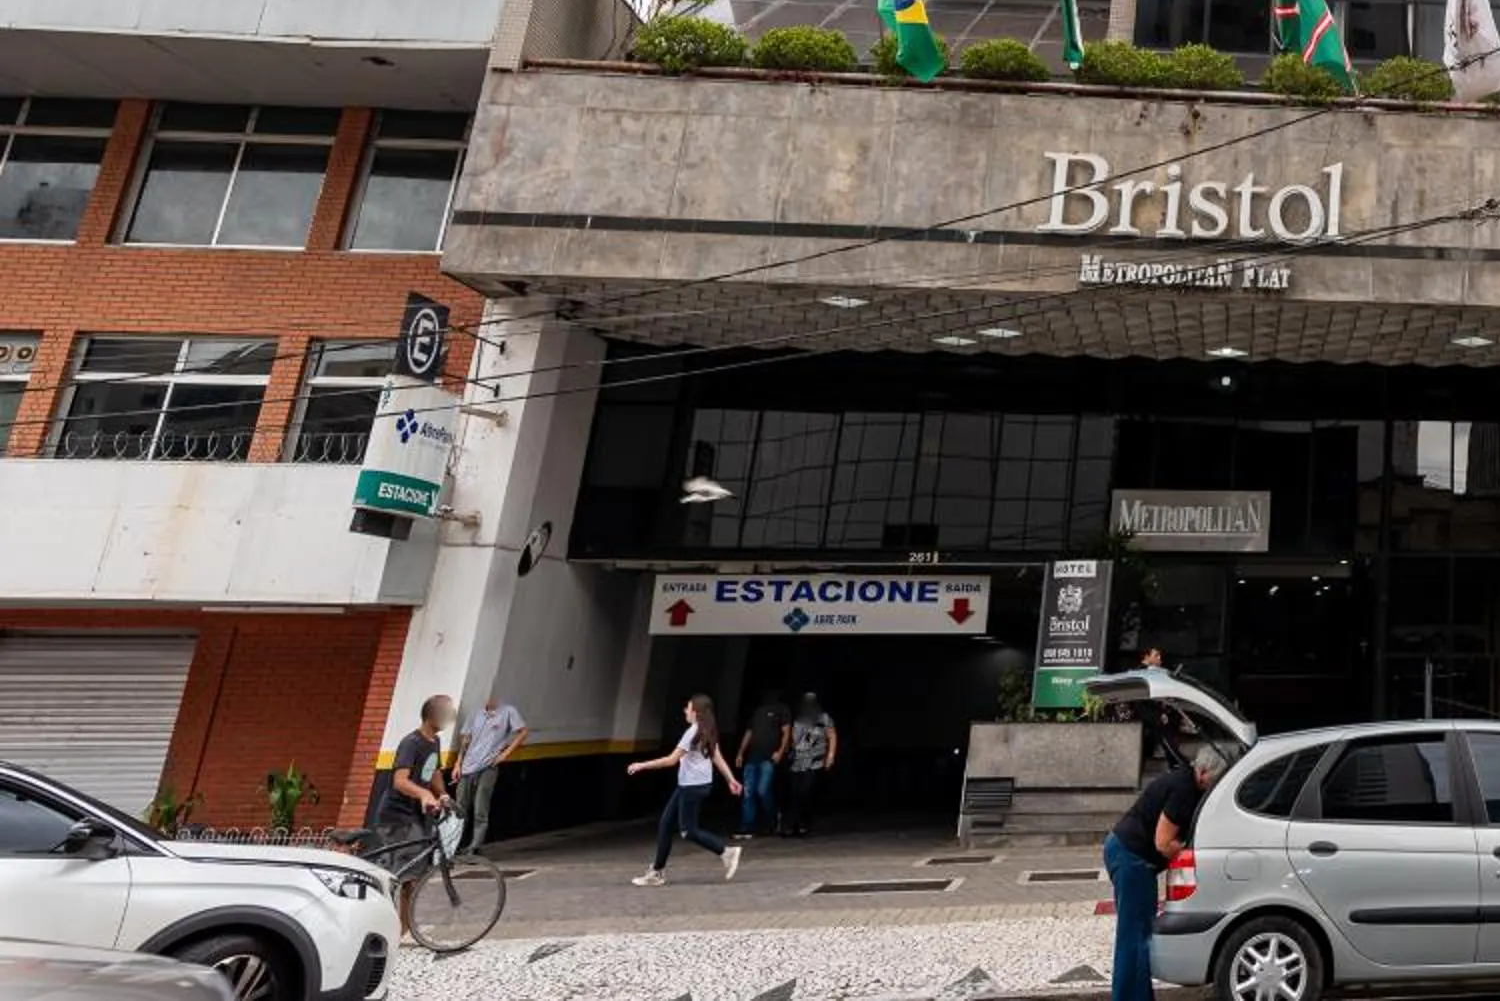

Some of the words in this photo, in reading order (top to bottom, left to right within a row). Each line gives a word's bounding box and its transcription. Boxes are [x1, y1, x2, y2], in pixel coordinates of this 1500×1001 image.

[1036, 150, 1346, 246] Bristol
[1079, 254, 1233, 287] METROPOLITAN
[1242, 260, 1291, 289] FLAT
[1118, 500, 1263, 535] METROPOLITAN
[1055, 564, 1091, 574] HOTEL
[662, 582, 708, 593] ENTRADA
[714, 579, 940, 603] ESTACIONE
[1049, 614, 1091, 632] Bristol
